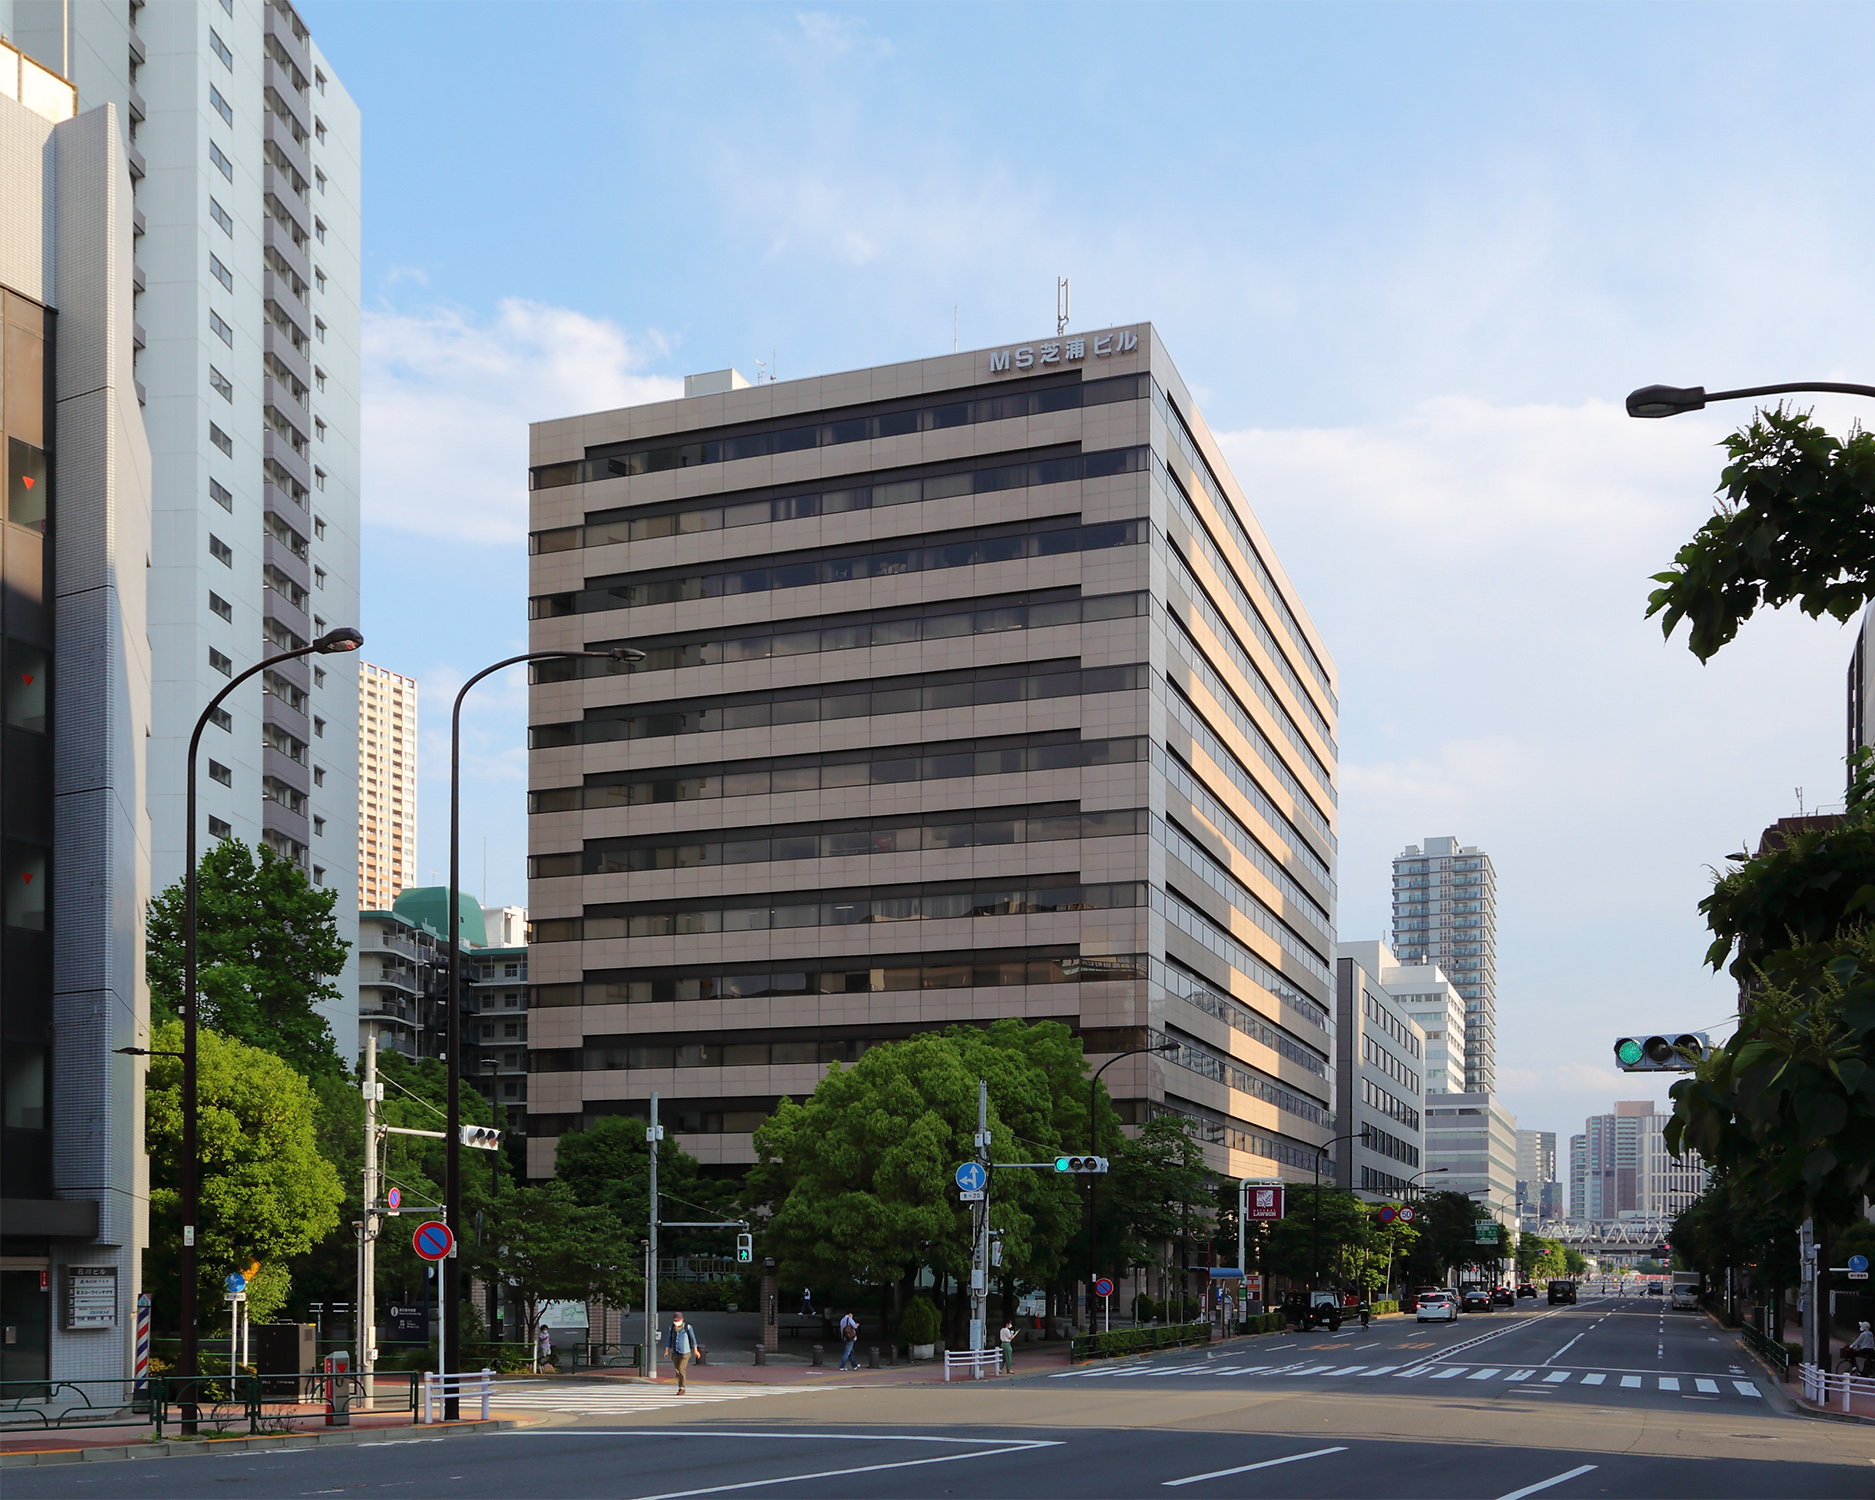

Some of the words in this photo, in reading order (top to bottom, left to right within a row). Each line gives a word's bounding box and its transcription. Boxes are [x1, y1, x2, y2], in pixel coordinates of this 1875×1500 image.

[989, 330, 1138, 372] MS芝浦ビル
[1401, 1210, 1412, 1219] 50
